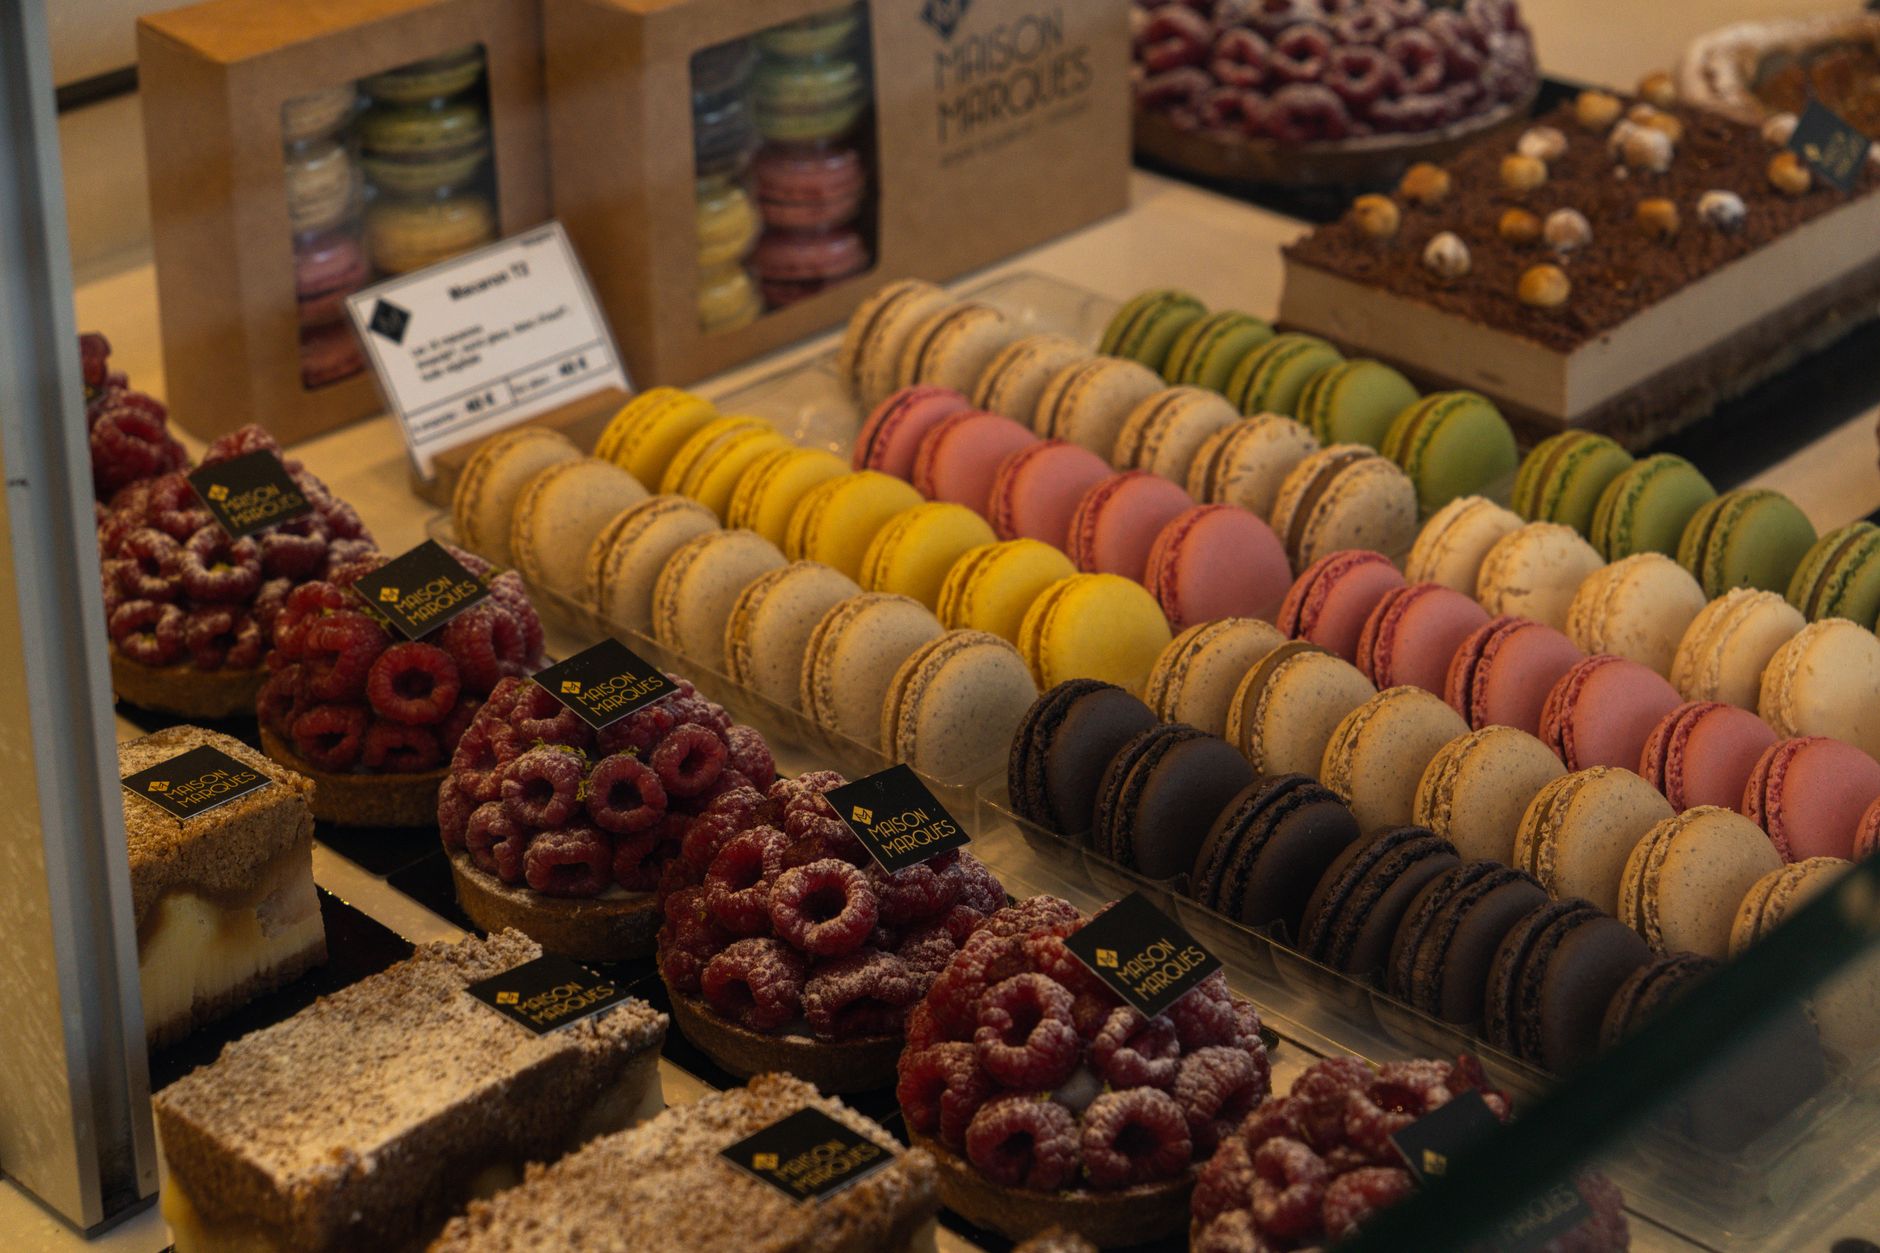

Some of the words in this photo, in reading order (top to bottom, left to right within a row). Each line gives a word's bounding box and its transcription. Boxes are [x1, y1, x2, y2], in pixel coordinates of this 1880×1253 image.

[935, 6, 1063, 92] MAISON
[938, 45, 1093, 144] MARQUES
[220, 483, 280, 513] MAISON
[230, 492, 303, 527] MARQUES
[393, 576, 453, 614] MAISON
[406, 580, 478, 625] MARQUES
[576, 671, 637, 705] MAISON
[589, 676, 664, 716] MARQUES
[163, 769, 229, 800] MAISON
[177, 771, 256, 808] MARQUES
[867, 808, 930, 841] MAISON
[881, 820, 956, 858] MARQUES
[1115, 937, 1176, 985] MAISON
[1133, 945, 1206, 1001] MARQUES
[514, 980, 584, 1015] MAISON
[529, 985, 615, 1025] MARQUES
[771, 1138, 847, 1182] MAISON
[791, 1142, 881, 1193] MARQUES
